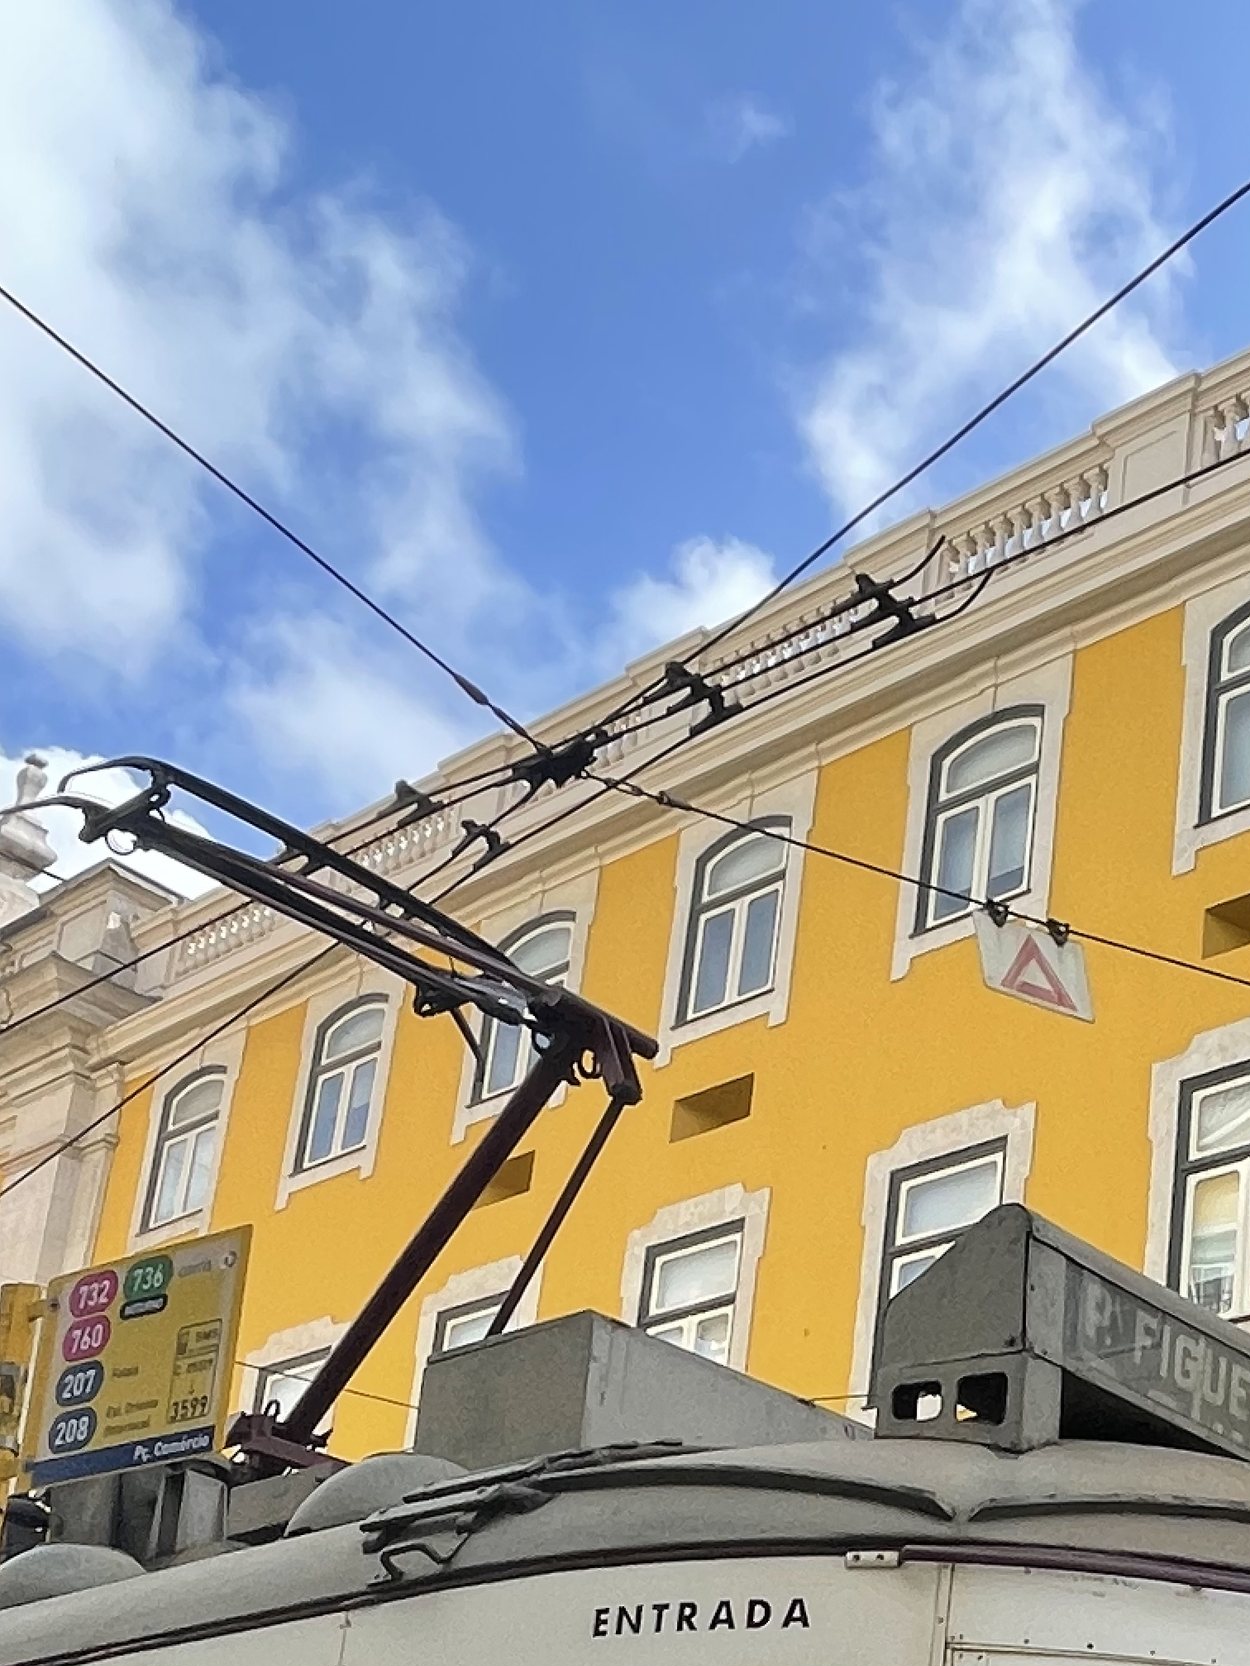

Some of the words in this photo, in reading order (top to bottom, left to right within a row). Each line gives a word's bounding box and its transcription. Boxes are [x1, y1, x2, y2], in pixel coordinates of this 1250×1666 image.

[77, 1278, 111, 1309] 732
[131, 1263, 165, 1293] 736
[71, 1323, 104, 1354] 760
[61, 1368, 97, 1399] 207
[170, 1395, 208, 1420] 3599
[53, 1415, 91, 1447] 208
[592, 1597, 811, 1639] ENTRADA
